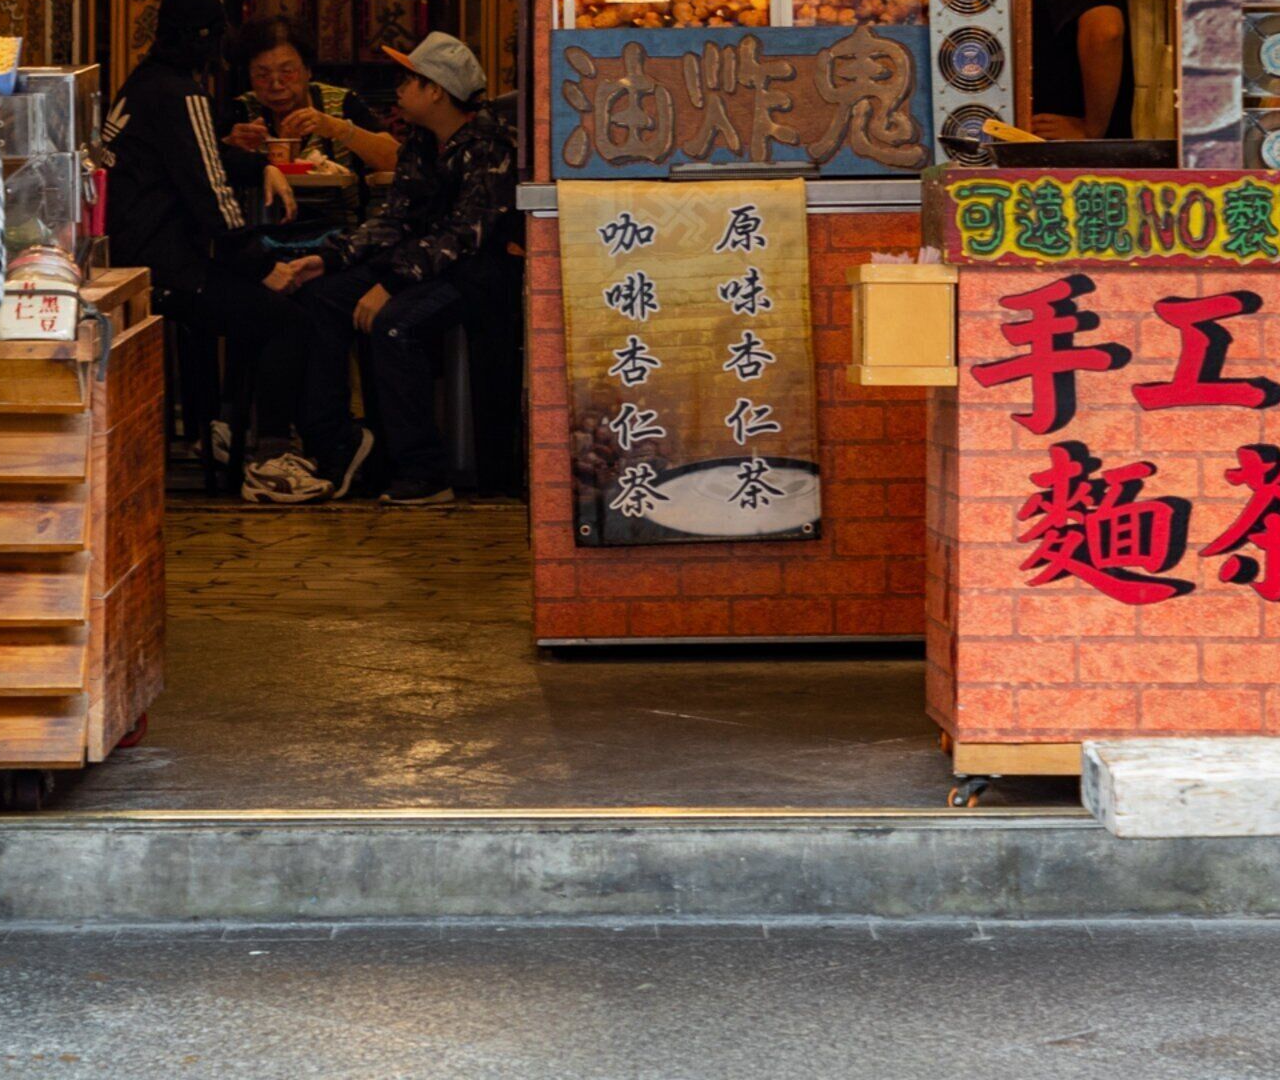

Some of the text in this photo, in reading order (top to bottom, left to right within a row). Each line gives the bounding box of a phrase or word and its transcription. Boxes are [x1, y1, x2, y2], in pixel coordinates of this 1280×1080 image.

[563, 22, 928, 170] 油炸鬼
[599, 213, 671, 516] 咖啡杏仁茶
[714, 205, 785, 510] 原味杏仁茶
